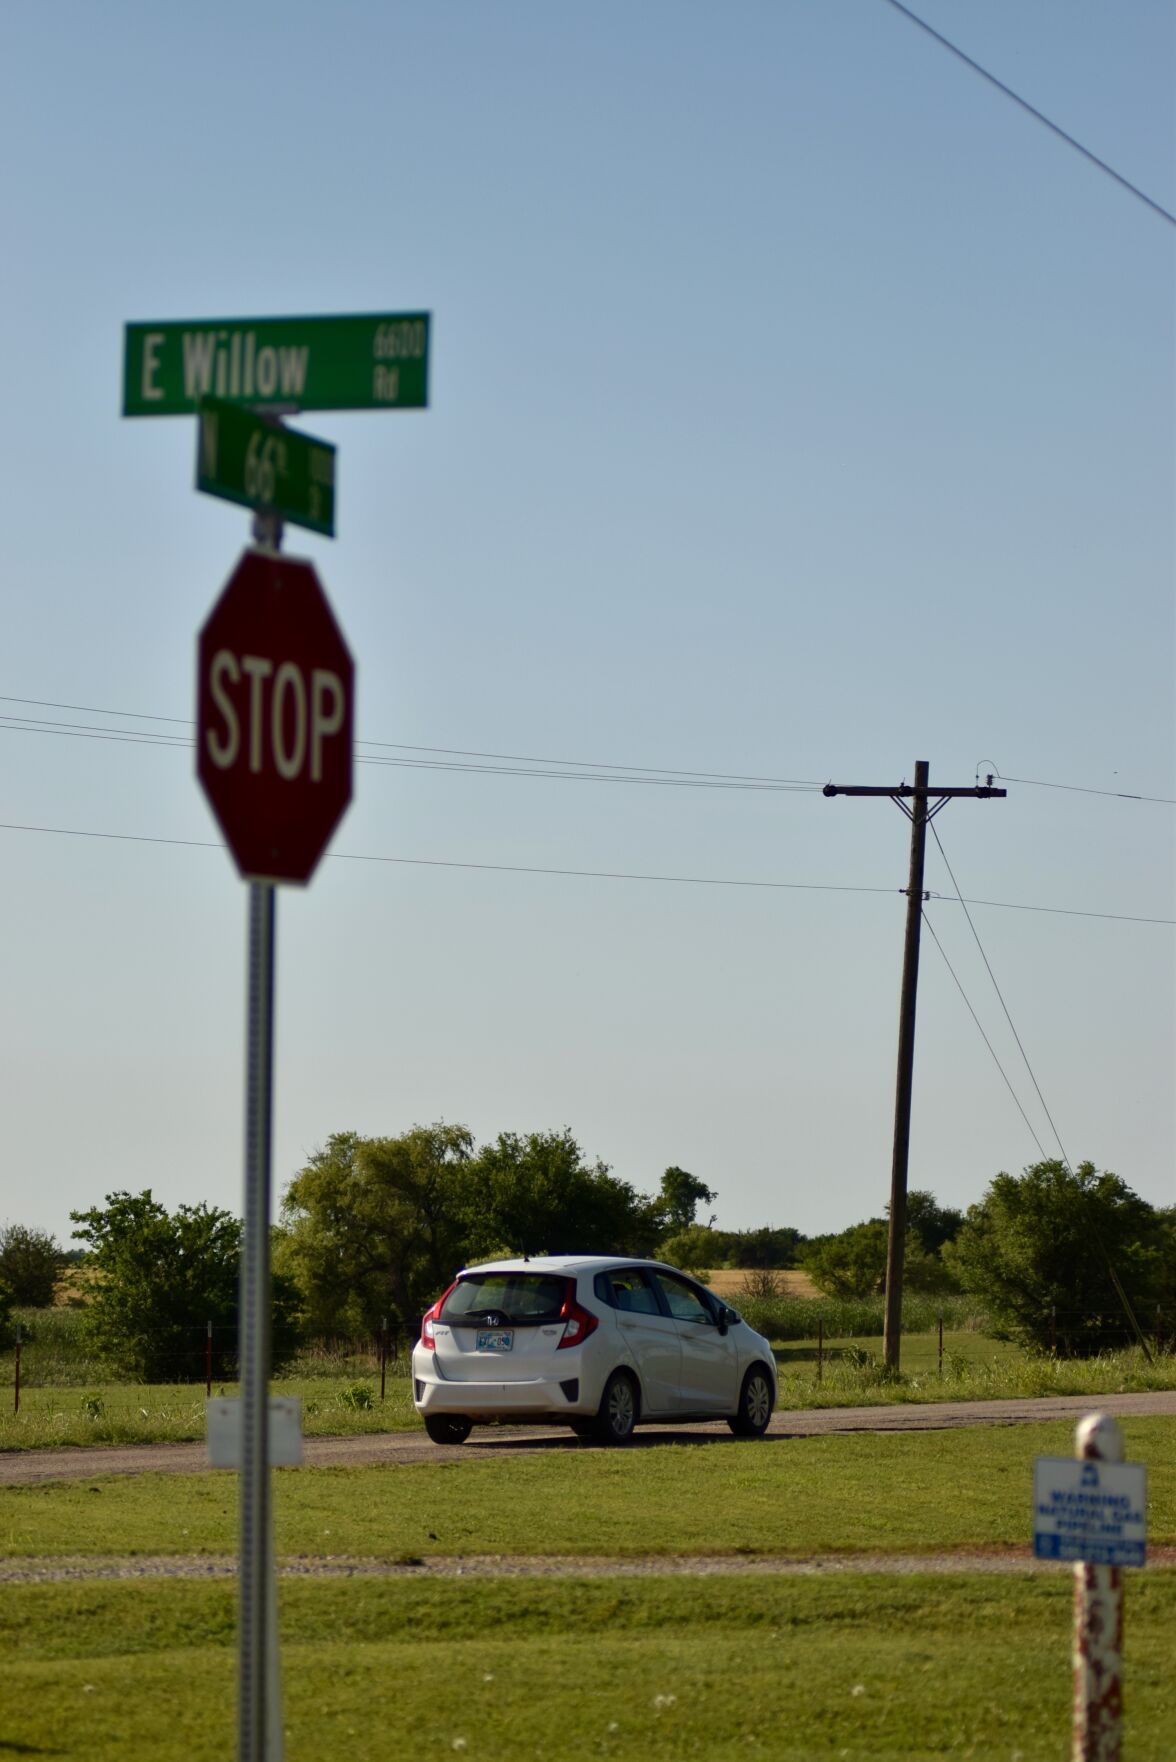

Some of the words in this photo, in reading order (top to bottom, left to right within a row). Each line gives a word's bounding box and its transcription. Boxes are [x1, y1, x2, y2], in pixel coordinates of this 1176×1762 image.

[141, 332, 165, 400] E
[183, 330, 310, 398] Willow
[373, 364, 399, 401] Rd
[207, 649, 346, 783] STOP
[1050, 1490, 1130, 1508] WARNING
